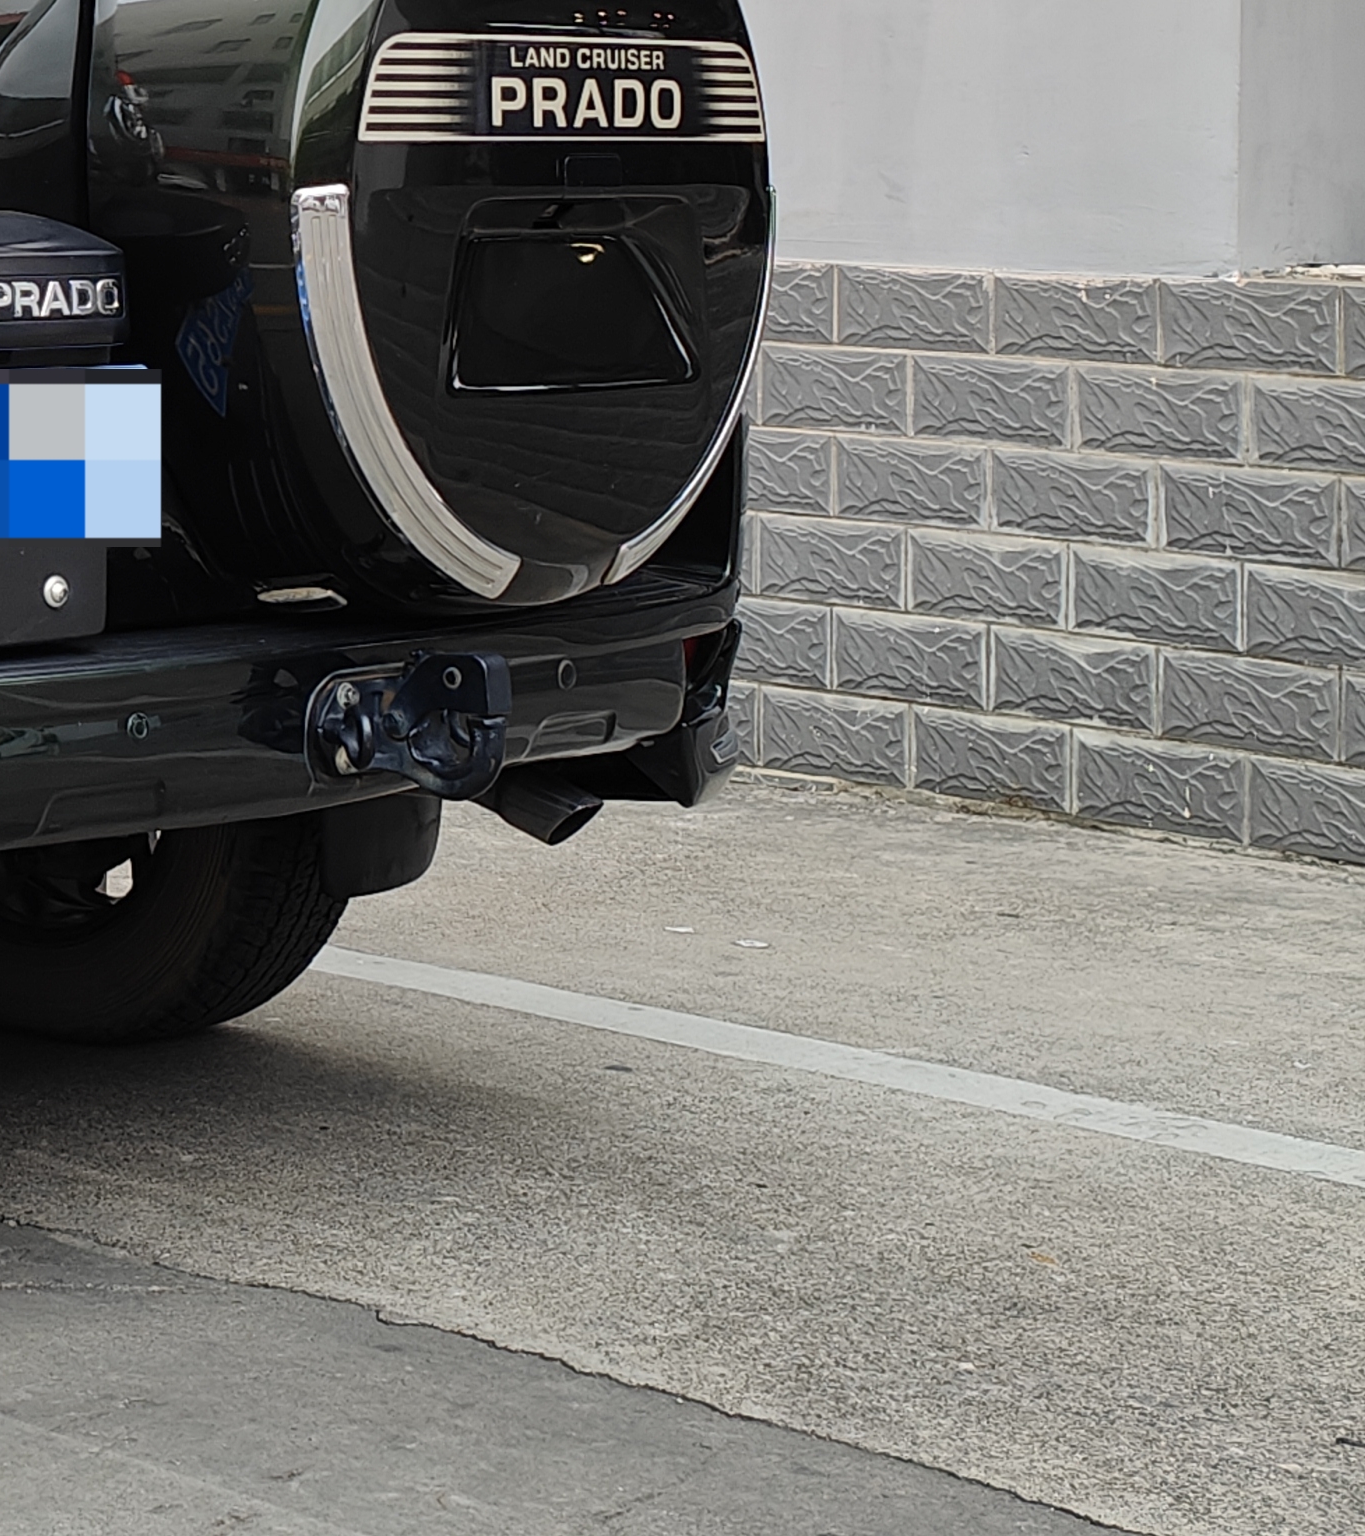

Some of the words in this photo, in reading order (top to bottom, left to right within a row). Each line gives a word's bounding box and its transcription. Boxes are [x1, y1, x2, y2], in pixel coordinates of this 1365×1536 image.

[510, 46, 570, 68] LAND
[576, 47, 665, 70] CRUISER
[491, 76, 682, 129] PRADO
